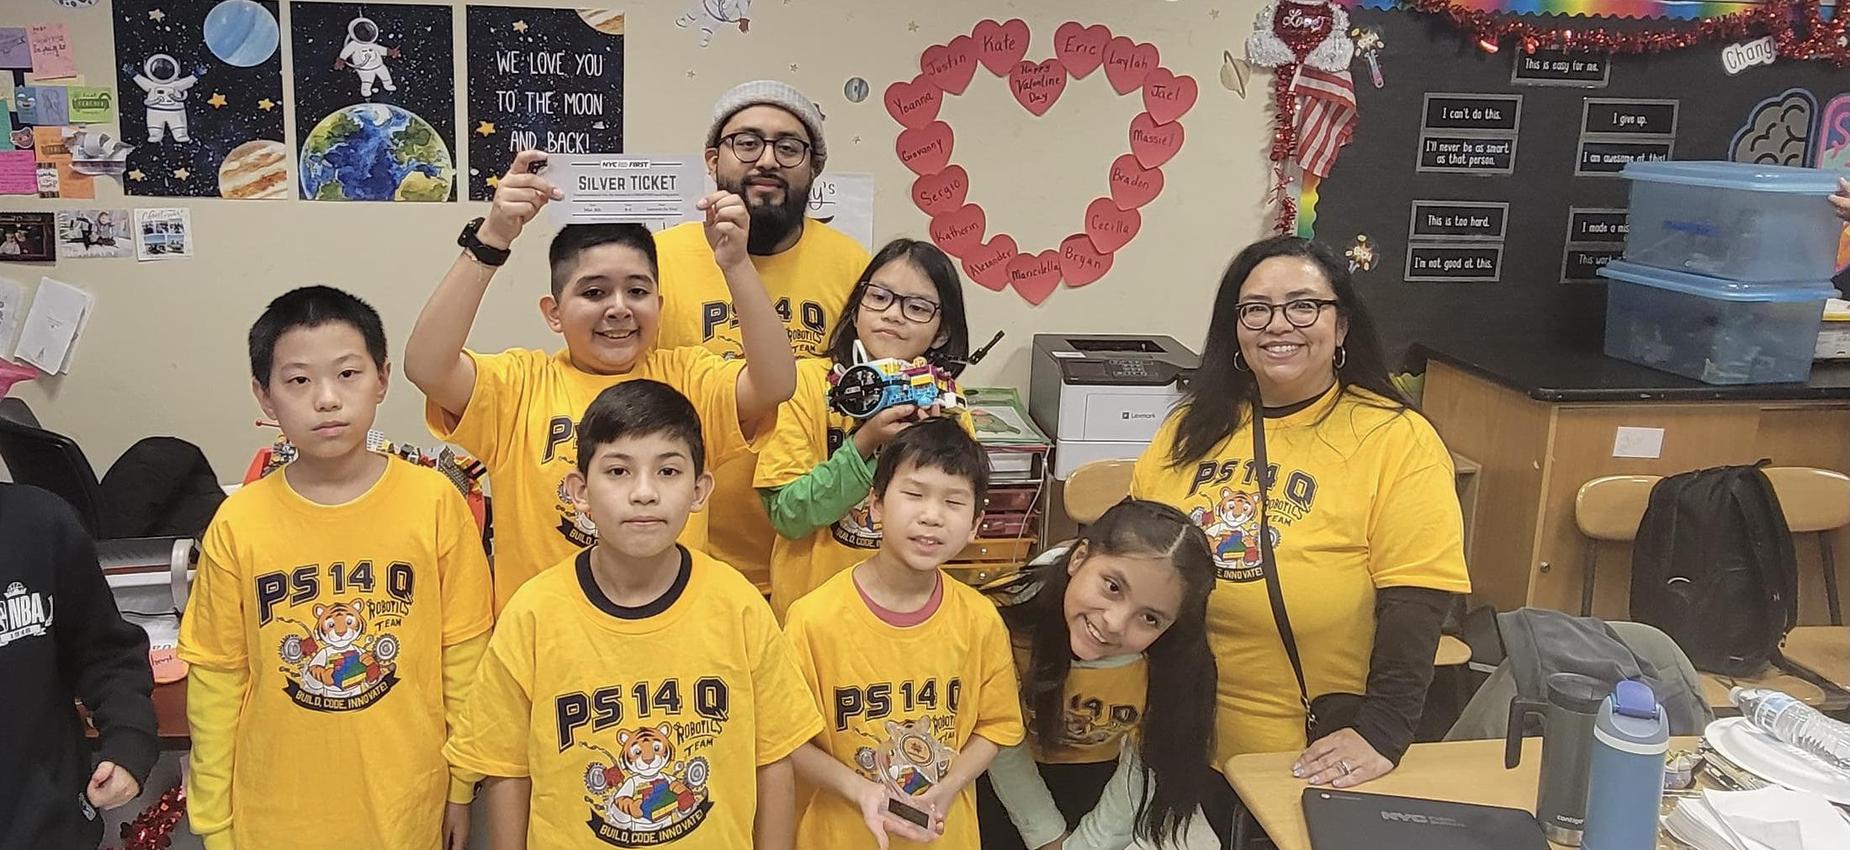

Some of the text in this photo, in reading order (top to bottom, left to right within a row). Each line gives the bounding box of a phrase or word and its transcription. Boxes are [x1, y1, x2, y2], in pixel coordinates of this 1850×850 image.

[983, 33, 1016, 52] Kate
[1064, 35, 1096, 55] Eric
[496, 51, 603, 77] WE LOVE YOU
[926, 53, 966, 76] Justin
[1109, 50, 1148, 72] Laylah
[1726, 40, 1773, 69] Chang
[1021, 64, 1051, 75] Happy
[1525, 58, 1599, 73] This is easy for me.
[496, 90, 603, 115] TO THE MOON
[1029, 92, 1048, 104] Day
[1151, 85, 1180, 101] Jael
[893, 92, 934, 115] Yoanna
[1442, 107, 1502, 120] I can't do this.
[1612, 112, 1648, 127] I give up.
[510, 131, 590, 154] AND BACK!
[1133, 129, 1174, 147] Massiel
[1426, 141, 1510, 154] I'll never be as smart
[1436, 154, 1495, 168] as that person.
[1583, 151, 1588, 163] I
[1590, 154, 1601, 163] am
[1603, 154, 1634, 163] awesome
[1637, 152, 1645, 162] at
[578, 175, 676, 191] SILVER TICKET
[1113, 168, 1149, 190] Braden
[811, 181, 835, 210] y's
[920, 180, 960, 206] Sergio
[1427, 214, 1490, 227] This is too hard.
[1582, 221, 1586, 232] I
[1588, 222, 1608, 233] made
[1610, 224, 1616, 233] a
[969, 249, 1012, 277] Alexander
[1065, 247, 1100, 270] Bryan
[1414, 257, 1493, 271] I'm not good at this.
[1580, 254, 1593, 264] This
[774, 297, 792, 322] 4
[800, 300, 826, 335] Q
[791, 345, 816, 353] TEAM
[1184, 459, 1241, 499] PS
[1283, 469, 1318, 513] Q
[1223, 567, 1264, 580] INNOVATE!
[254, 560, 415, 628] PS 14 Q
[8, 592, 45, 630] NBA
[367, 599, 409, 620] ROBOTICS
[375, 617, 402, 631] TEAM
[348, 681, 389, 709] INNOVATE!
[833, 682, 892, 732] PS
[899, 677, 937, 712] 14
[555, 676, 729, 754] PS 14 Q
[673, 720, 723, 746] ROBOTICS
[684, 738, 714, 757] TEAM
[600, 823, 629, 844] BUILD,
[659, 809, 703, 841] INNOVATE!
[1381, 811, 1428, 823] NYC
[1556, 814, 1584, 825] contigo
